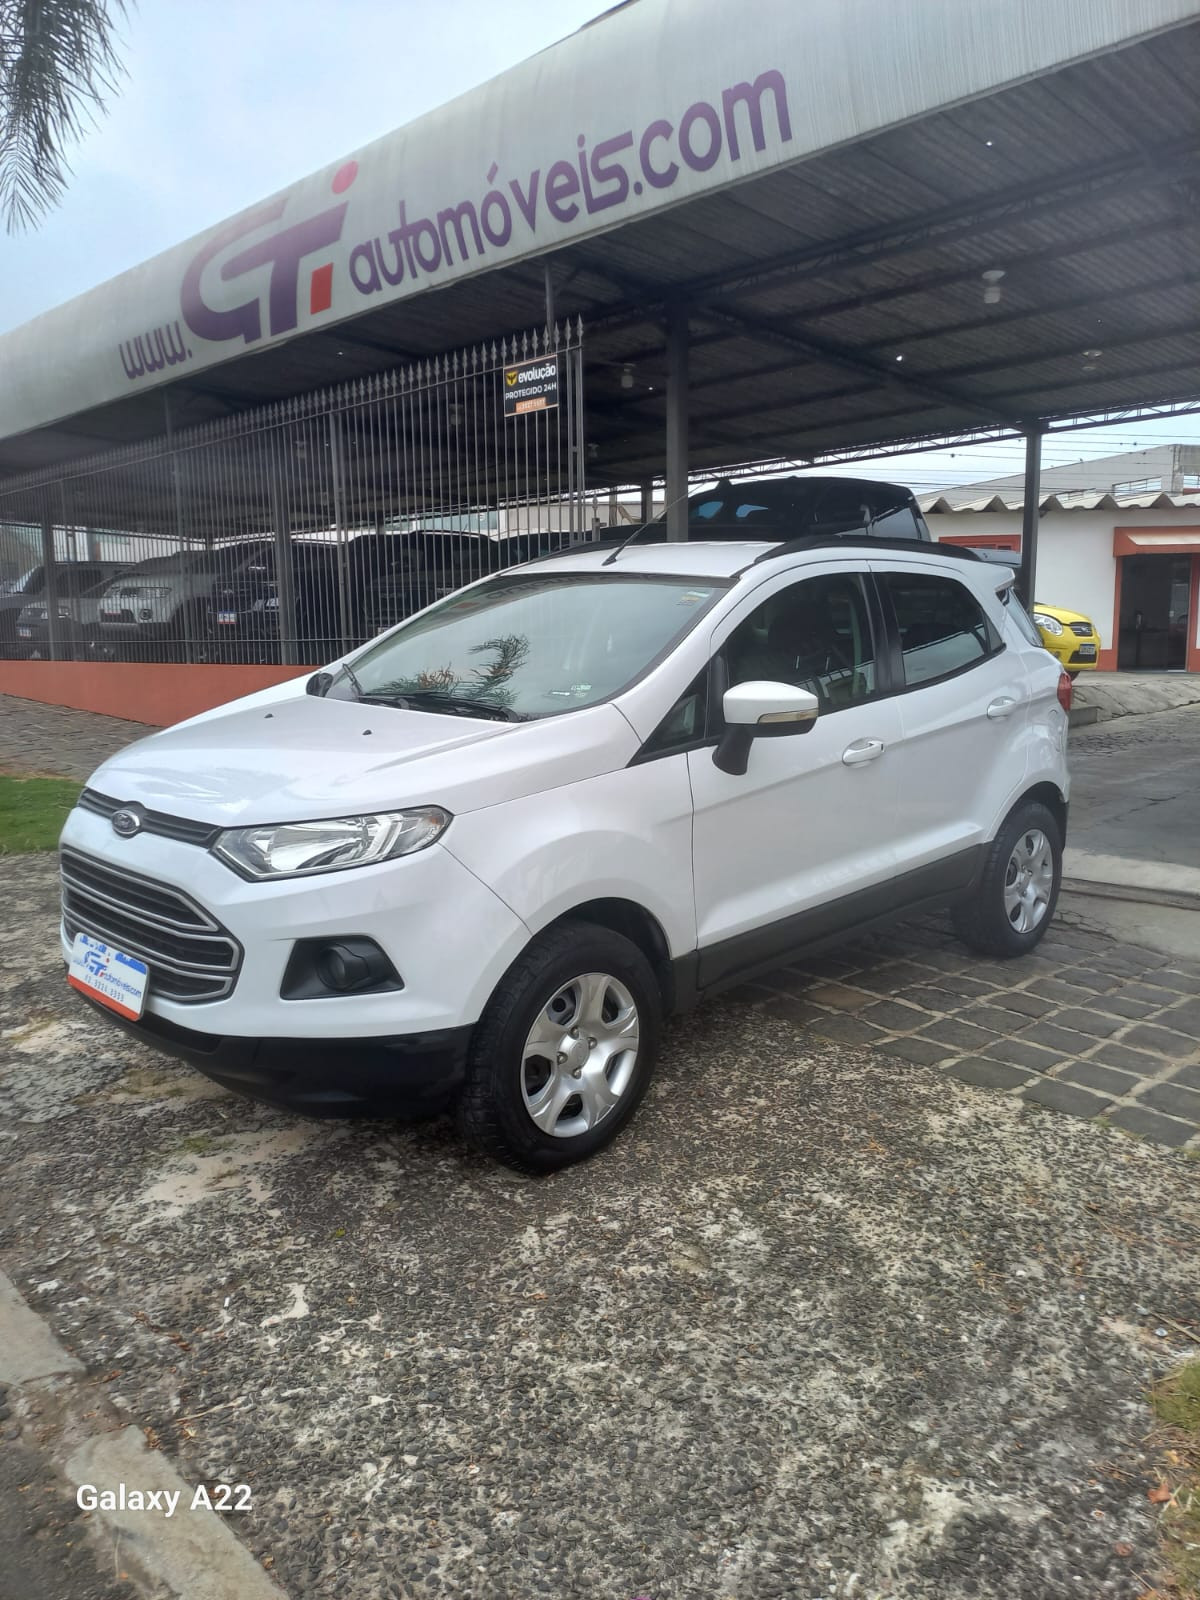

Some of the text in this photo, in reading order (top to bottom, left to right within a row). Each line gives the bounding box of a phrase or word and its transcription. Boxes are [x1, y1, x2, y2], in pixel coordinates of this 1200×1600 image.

[348, 69, 793, 296] automóveis.com
[518, 363, 556, 383] evolução
[505, 381, 557, 400] PROTEGIDO 24H
